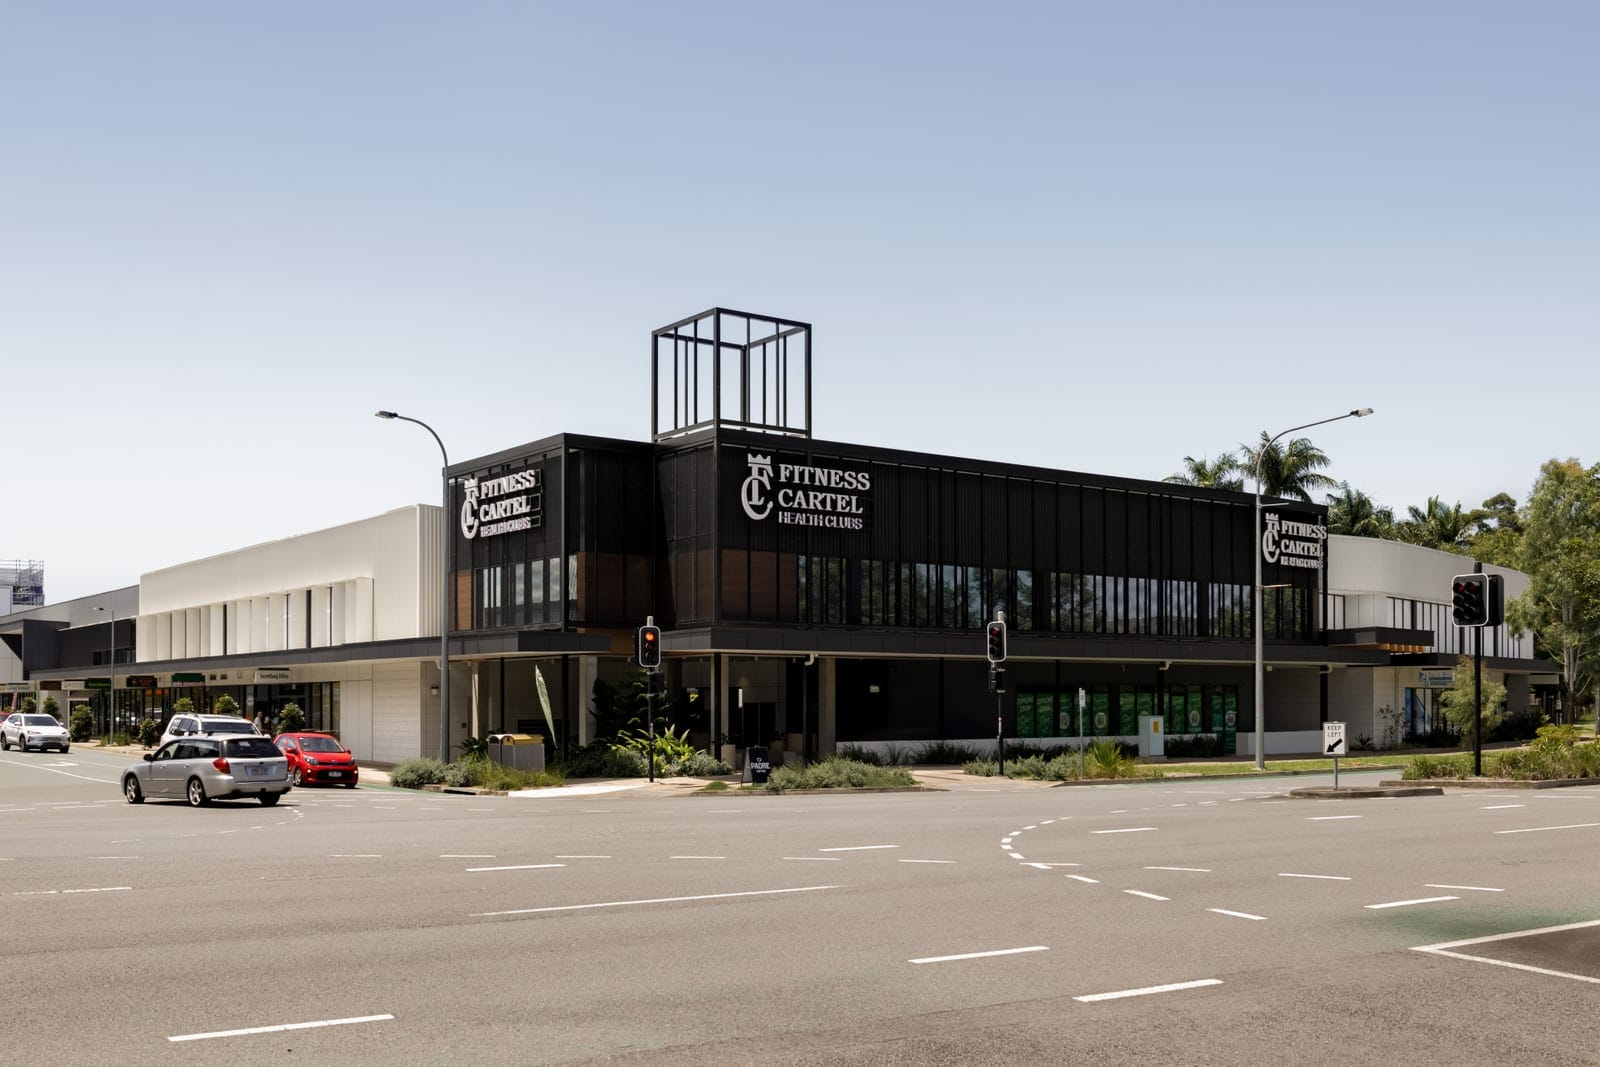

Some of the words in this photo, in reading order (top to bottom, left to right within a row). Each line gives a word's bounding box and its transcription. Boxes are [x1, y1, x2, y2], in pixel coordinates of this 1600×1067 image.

[480, 469, 536, 499] FITNESS
[778, 464, 871, 491] FITNESS
[479, 496, 531, 522] CARTEL
[778, 489, 863, 514] CARTEL
[778, 511, 824, 527] HEALTH
[824, 515, 863, 530] CLUBS
[1281, 520, 1327, 540] FITNESS
[1280, 539, 1324, 557] CARTEL
[750, 762, 770, 770] PADRE
